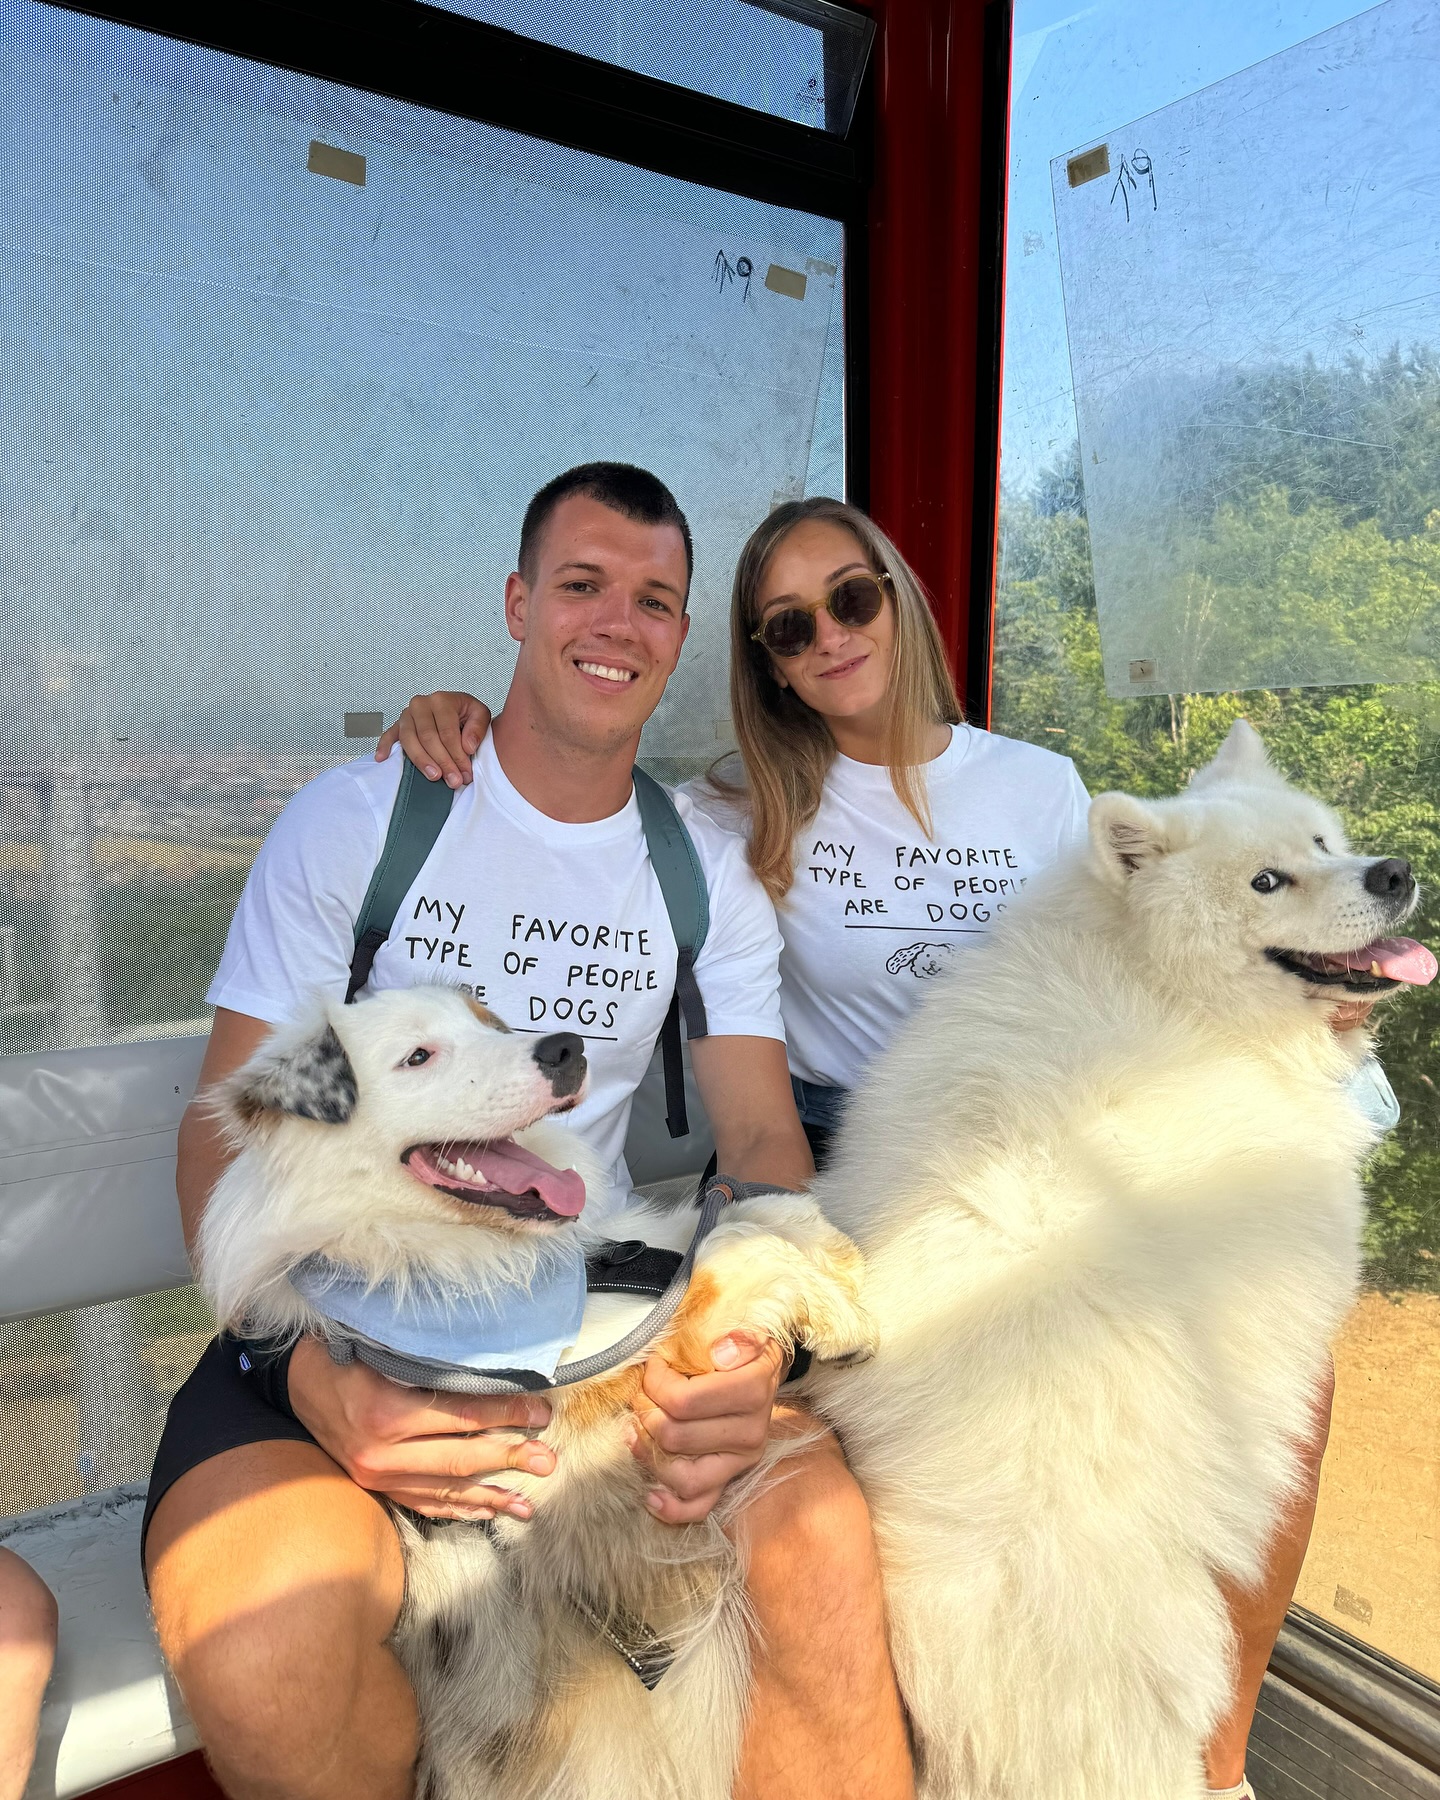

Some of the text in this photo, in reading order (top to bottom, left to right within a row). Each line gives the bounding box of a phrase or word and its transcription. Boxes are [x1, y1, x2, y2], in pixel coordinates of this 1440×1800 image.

[813, 840, 1019, 869] MY FAVORITE
[808, 866, 867, 889] TYPE
[894, 875, 926, 891] OF
[844, 898, 889, 916] ARE
[413, 896, 652, 956] MY FAVORITE
[404, 936, 658, 993] TYPE OF PEOPLE
[529, 995, 619, 1029] DOGS
